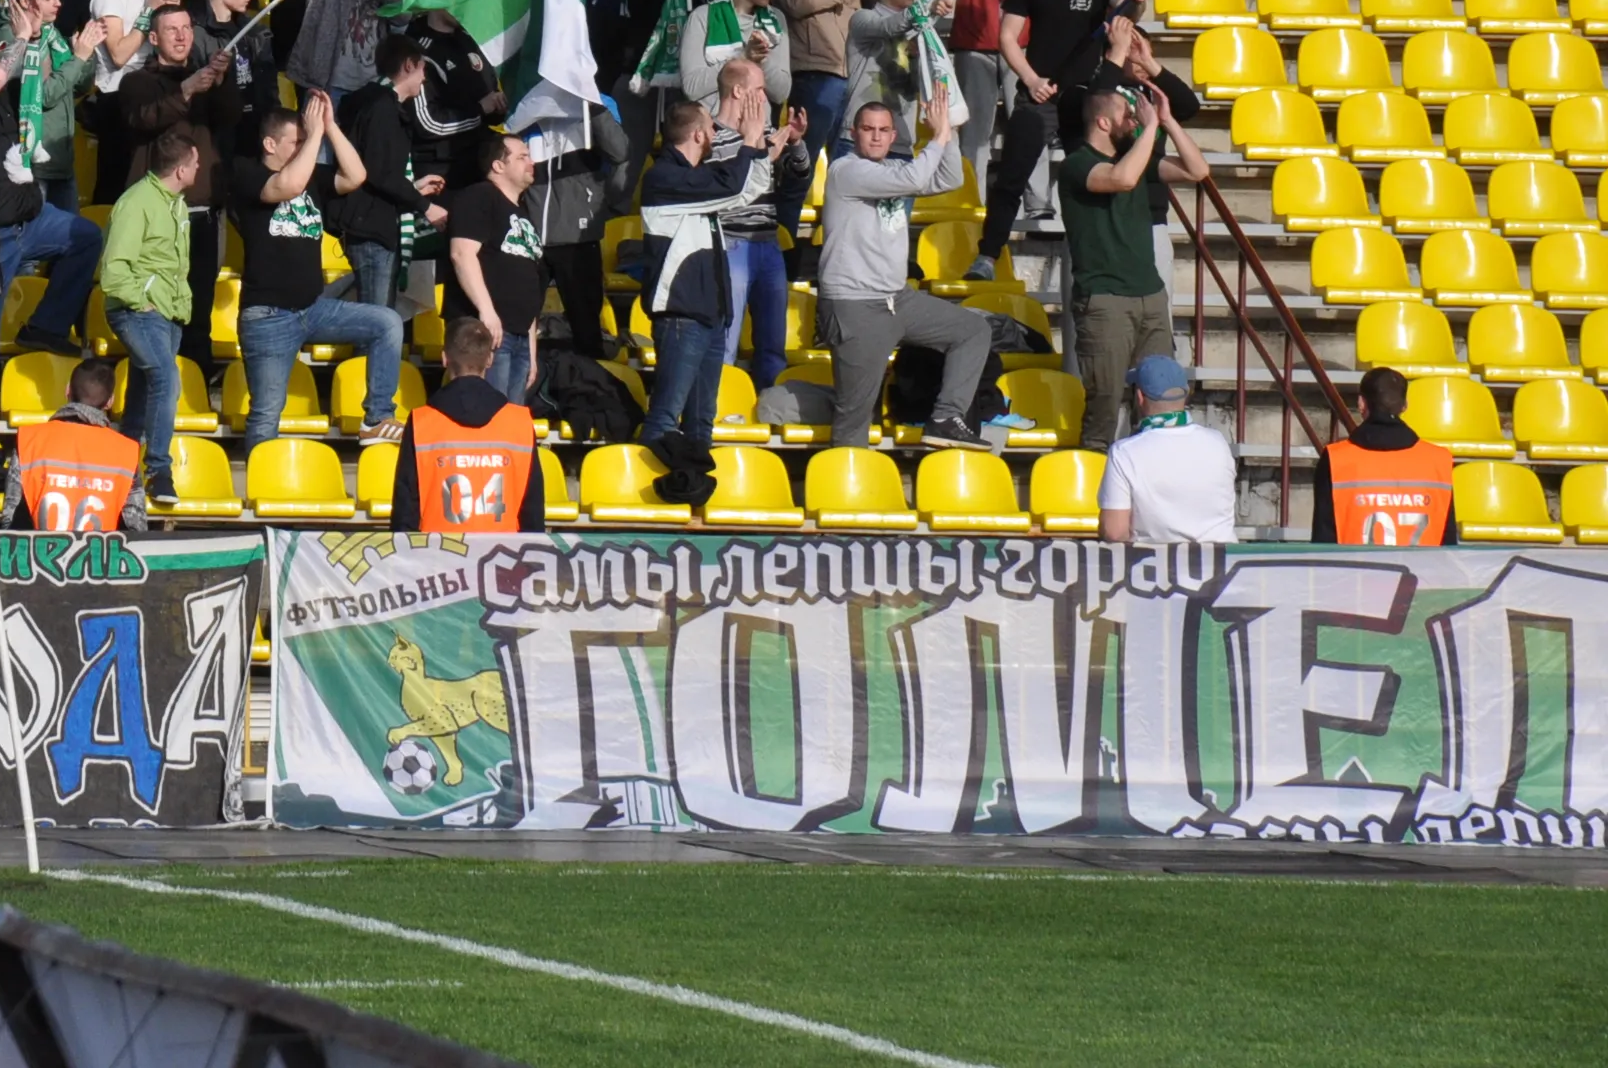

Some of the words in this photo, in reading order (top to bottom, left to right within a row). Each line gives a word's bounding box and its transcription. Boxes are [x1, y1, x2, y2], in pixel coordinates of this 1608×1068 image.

[436, 454, 510, 468] STEWARD
[45, 473, 115, 492] TEWARD
[441, 473, 506, 525] 04
[1355, 493, 1431, 507] STEWARD
[38, 491, 106, 531] 06
[1362, 511, 1429, 546] 07
[285, 567, 471, 627] ФУТБОЛЬНЫ
